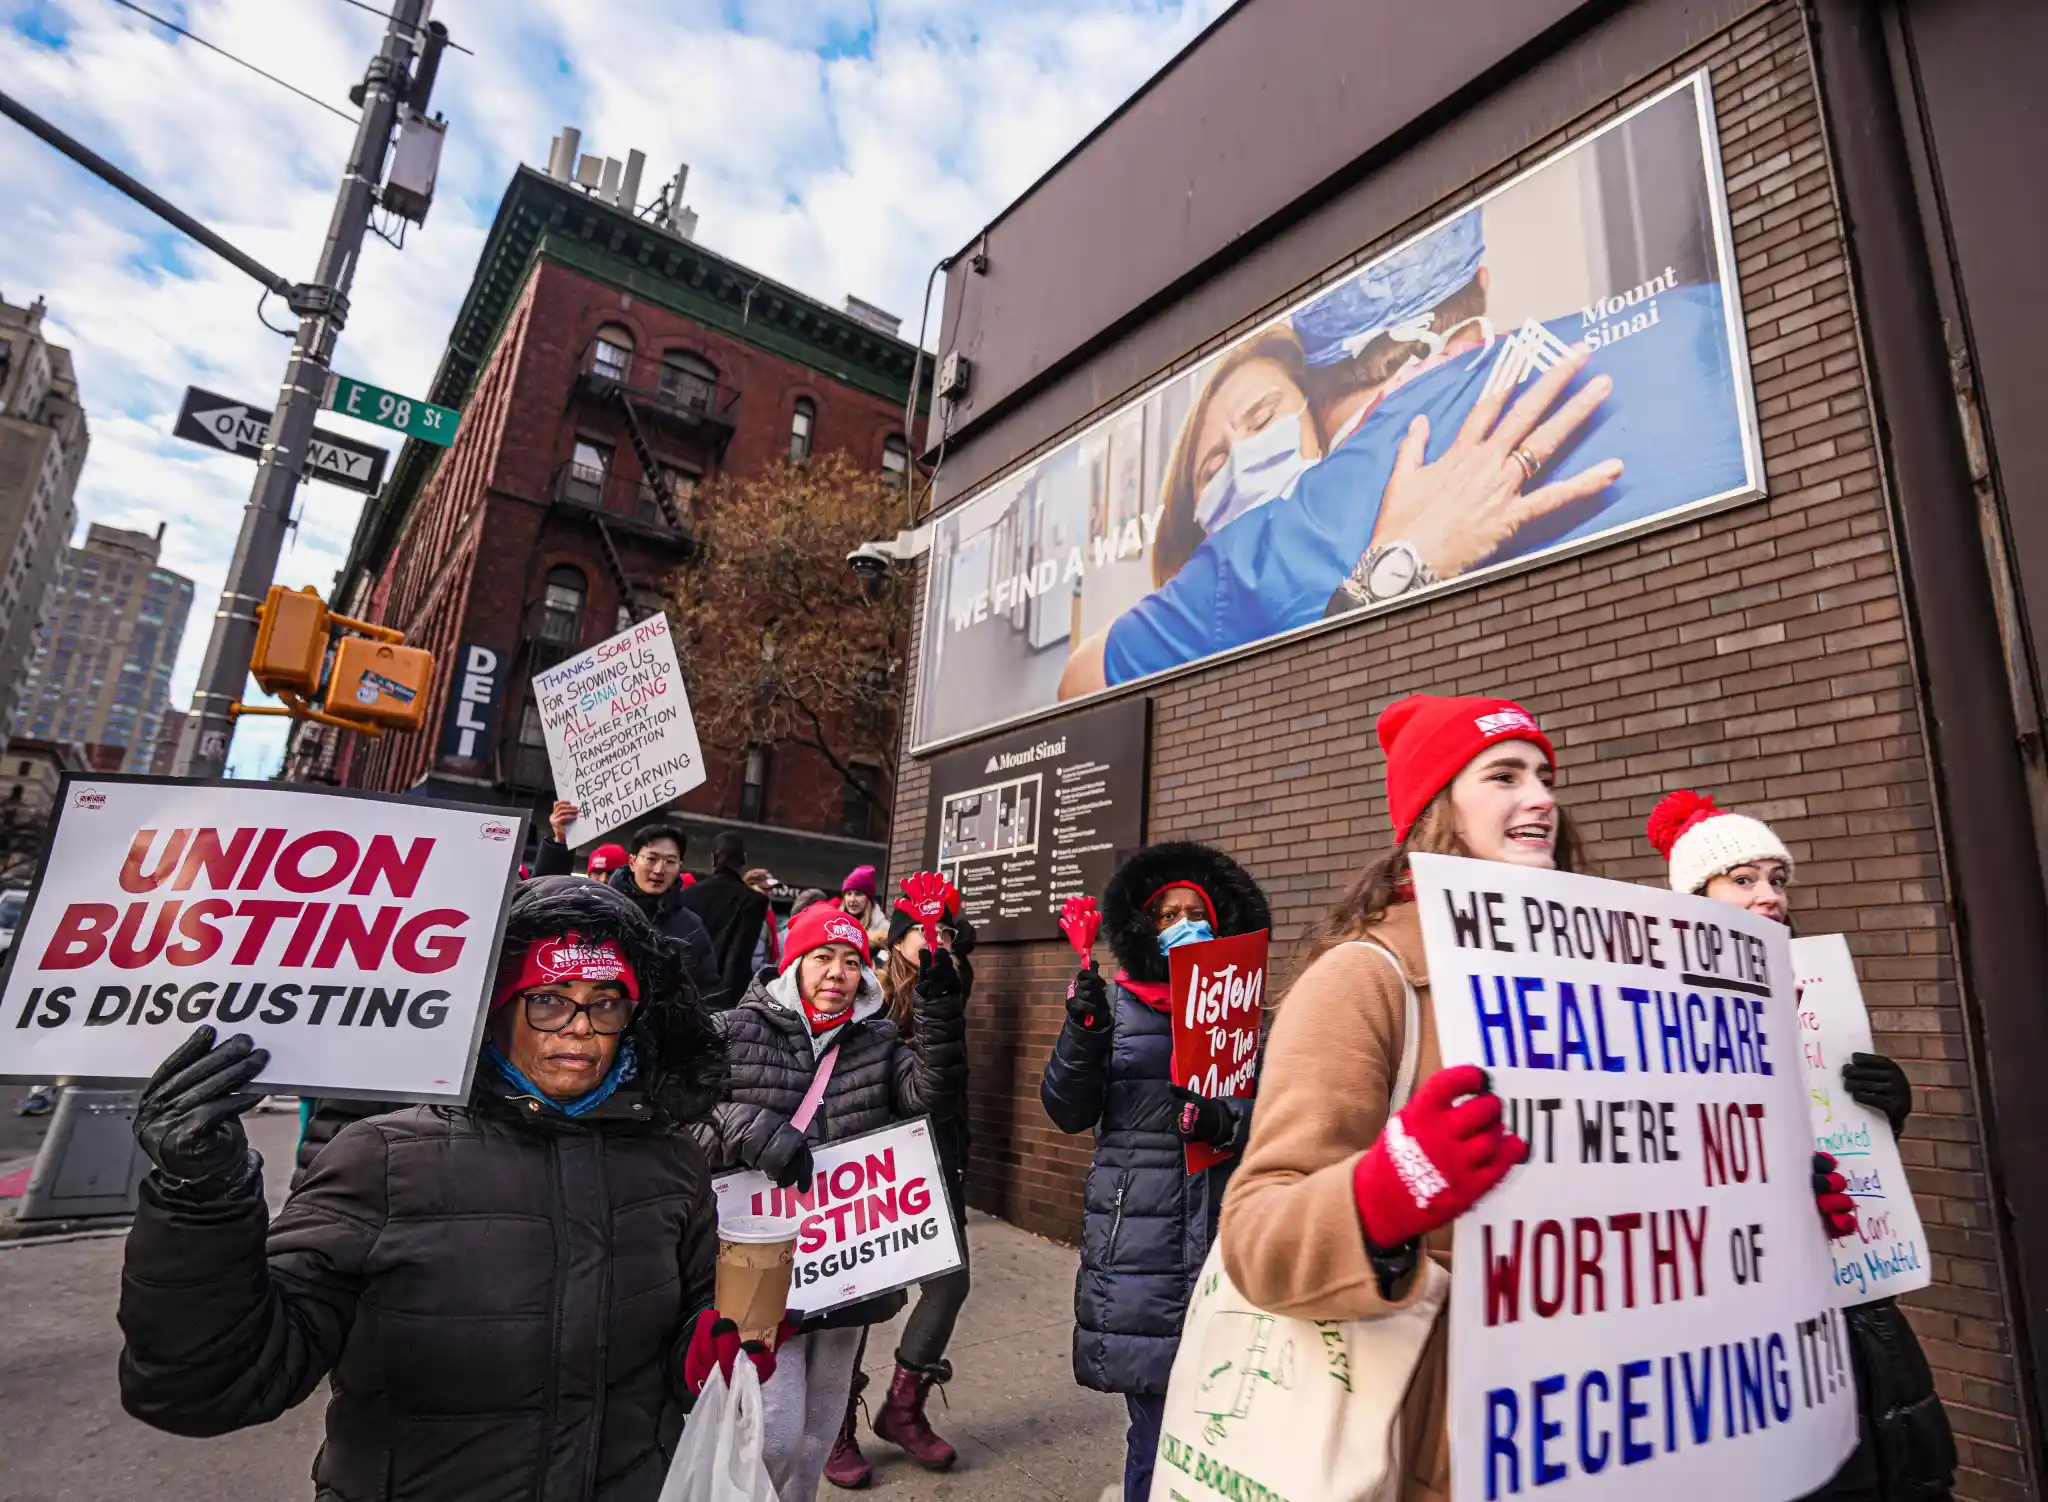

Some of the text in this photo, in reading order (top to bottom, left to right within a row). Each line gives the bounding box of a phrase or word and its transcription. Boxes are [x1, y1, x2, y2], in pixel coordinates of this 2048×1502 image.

[1580, 265, 1679, 329] Mount
[1583, 300, 1662, 352] Sinai
[215, 414, 270, 445] ONE
[347, 384, 443, 429] E 98 St
[954, 504, 1165, 633] WE FIND A WAY
[457, 645, 498, 757] DELI
[537, 657, 595, 692] THANKS
[542, 693, 565, 714] FOR
[566, 661, 629, 701] SHOWING
[545, 704, 578, 730] WHAT
[621, 668, 650, 693] CAN
[564, 676, 667, 742] ALL ALONG
[568, 704, 650, 753] HIGHER PAY
[569, 706, 677, 767] TRANSPORTATION
[575, 728, 665, 782] ACCOMMODATION
[575, 754, 642, 800] RESPECT
[615, 752, 691, 802] LEARNING
[999, 735, 1067, 771] Mount Sinai
[595, 779, 677, 832] MODULES
[119, 826, 437, 899] UNION
[38, 898, 470, 975] BUSTING
[1443, 888, 1771, 985] WE PROVIDE TOP TIER
[16, 981, 453, 1030] IS DISGUSTING
[1468, 974, 1774, 1076] HEALTHCARE
[1510, 1098, 1563, 1164] UT
[1696, 1101, 1768, 1187] NOT
[793, 1177, 931, 1257] STING
[794, 1217, 939, 1289] ISGUSTING
[1482, 1205, 1765, 1328] WORTHY OF
[1484, 1332, 1793, 1502] RECEIVING
